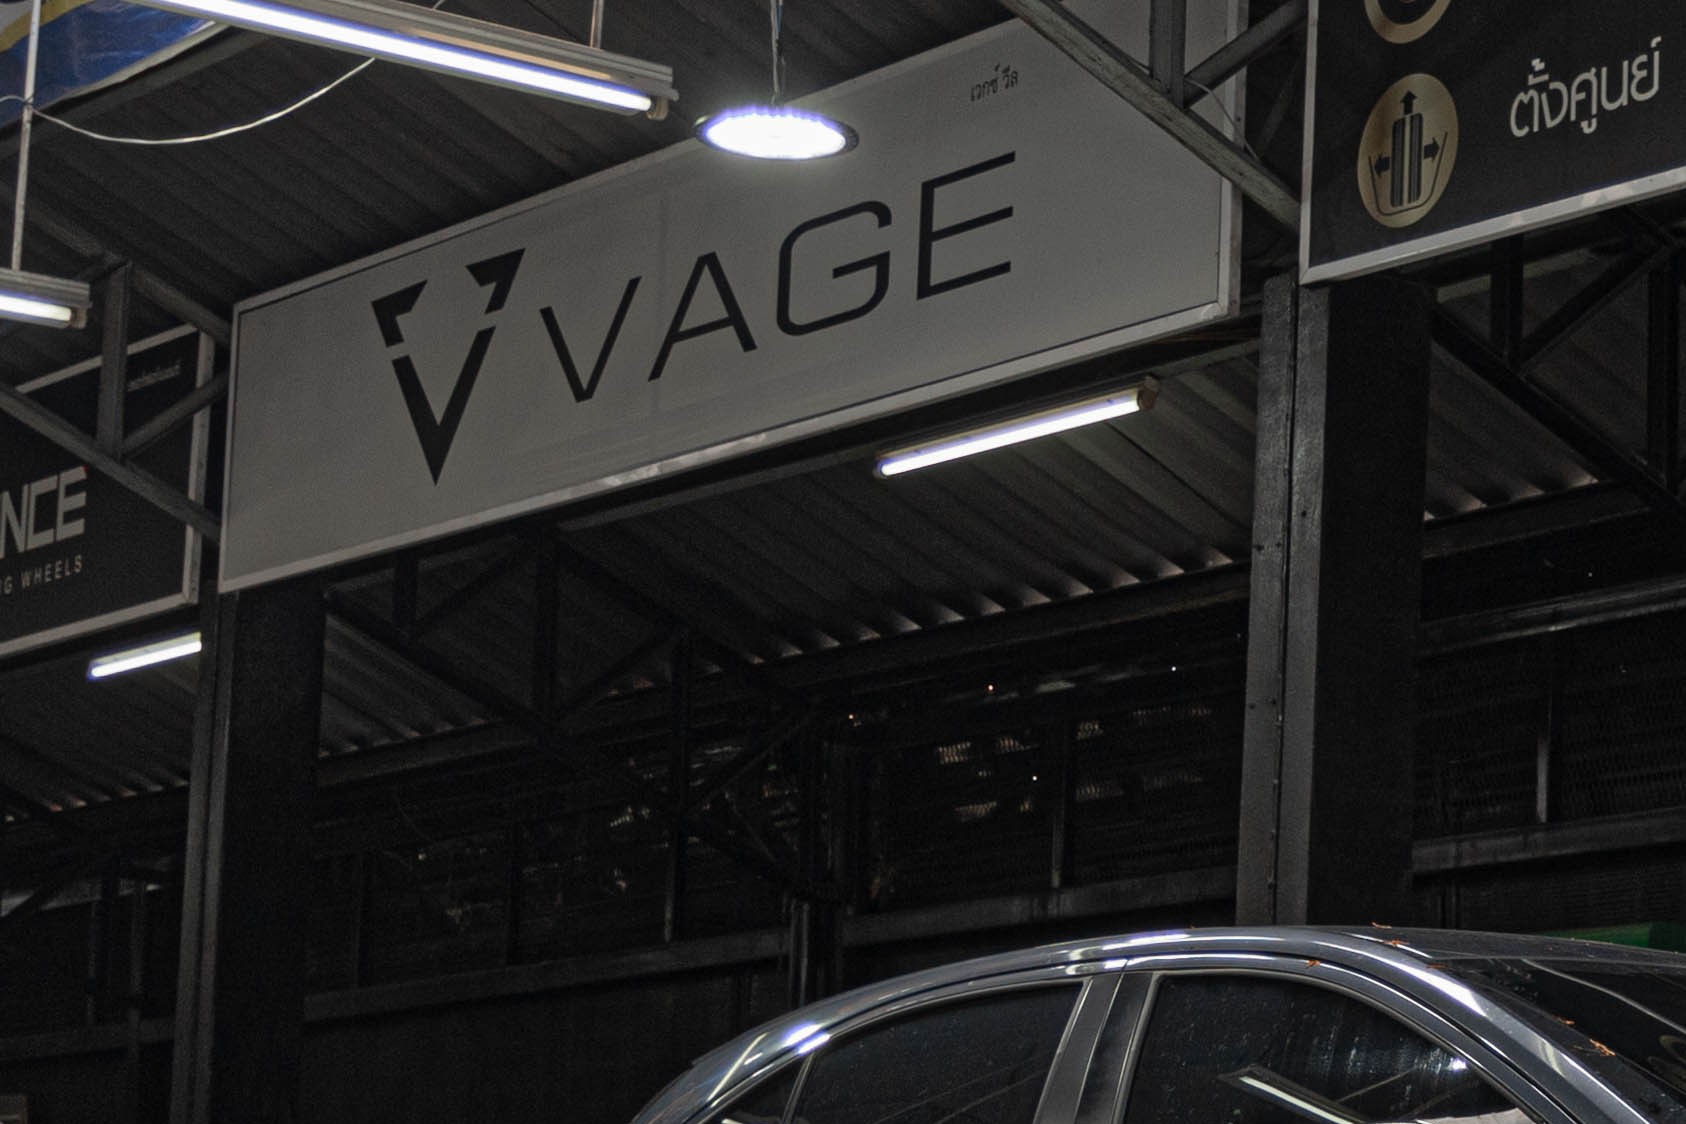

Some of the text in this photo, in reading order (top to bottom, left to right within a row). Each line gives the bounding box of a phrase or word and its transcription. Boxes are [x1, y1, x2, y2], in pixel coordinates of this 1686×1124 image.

[1510, 36, 1663, 137] ตั้งศูนย์
[538, 150, 1017, 403] VAGE
[20, 553, 83, 589] WHEELS
